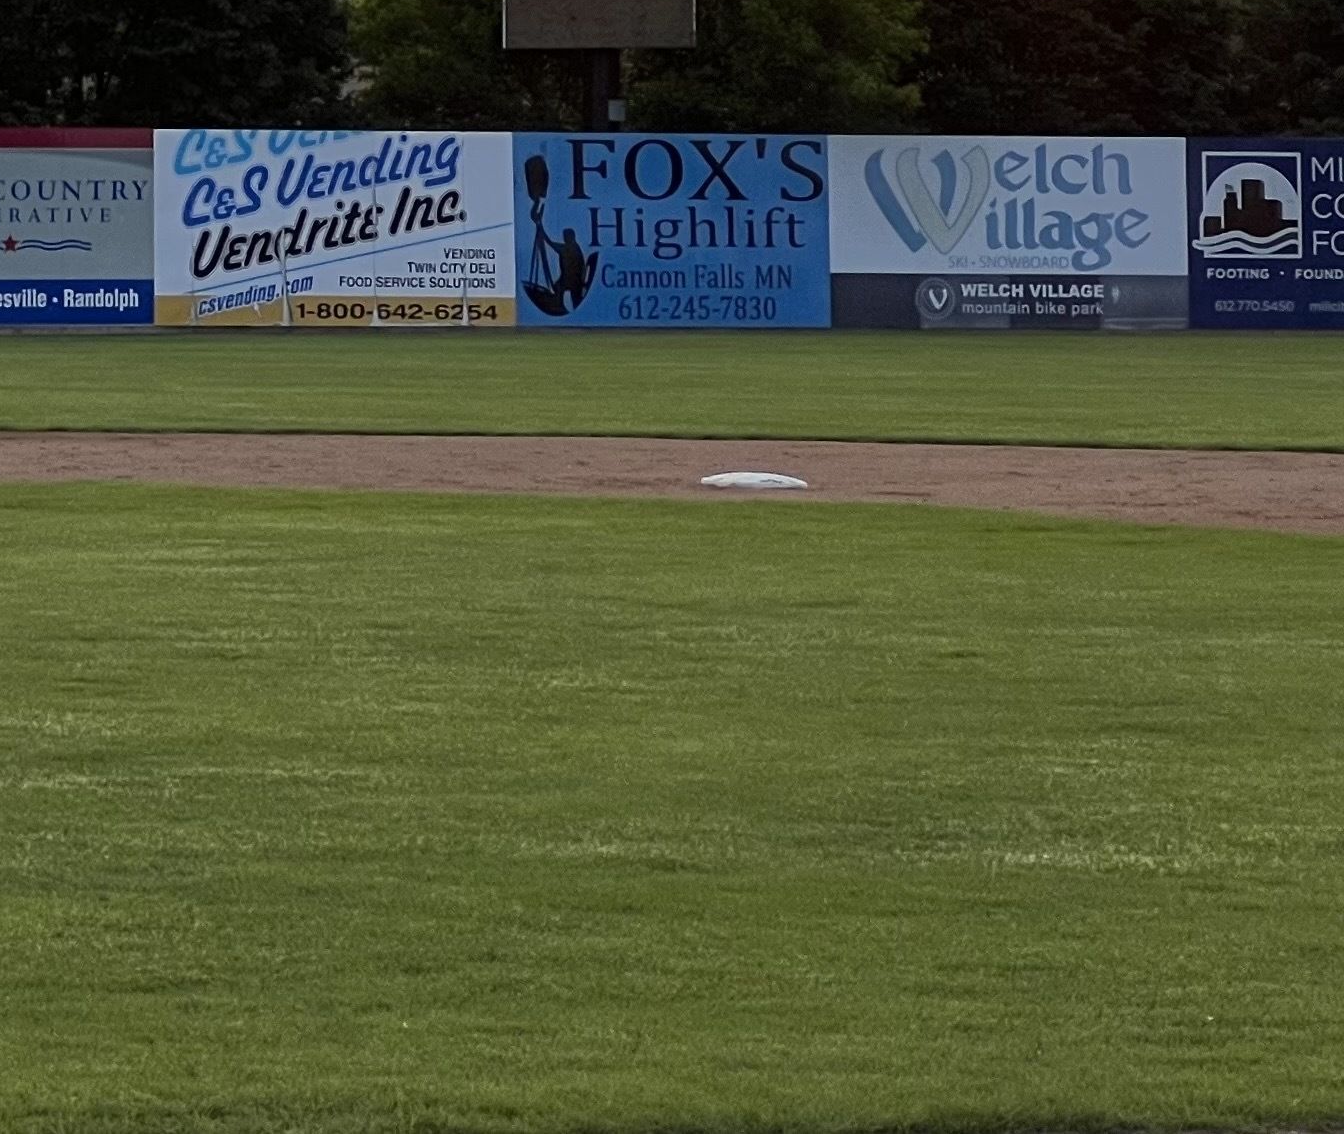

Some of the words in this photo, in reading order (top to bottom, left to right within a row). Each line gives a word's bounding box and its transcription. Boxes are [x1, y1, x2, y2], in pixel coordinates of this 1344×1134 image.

[182, 165, 269, 227] C&S
[276, 133, 462, 207] Vending
[566, 138, 824, 202] FOX'S
[388, 187, 468, 236] Inc.
[588, 206, 806, 260] Highlift
[443, 248, 496, 260] VENDING
[979, 257, 1070, 268] SNOWBOARD
[408, 262, 437, 273] TWIN
[440, 262, 465, 274] CITY
[468, 262, 496, 274] DELI
[601, 263, 687, 288] Cannon
[694, 263, 743, 288] Falls
[755, 265, 792, 289] MN
[1206, 268, 1270, 279] FOOTING
[339, 276, 372, 288] FOOD
[375, 277, 425, 288] SERVICE
[429, 276, 496, 289] SOLUTIONS
[961, 284, 1023, 297] WELCH
[1029, 284, 1104, 298] VILLAGE
[63, 288, 139, 312] Randolph
[199, 274, 314, 316] csvending.com
[296, 303, 498, 320] 1-800-642-6254
[618, 295, 776, 320] 612-245-7830
[962, 303, 1030, 315] mountain
[1035, 302, 1066, 315] bike
[1072, 303, 1103, 317] park
